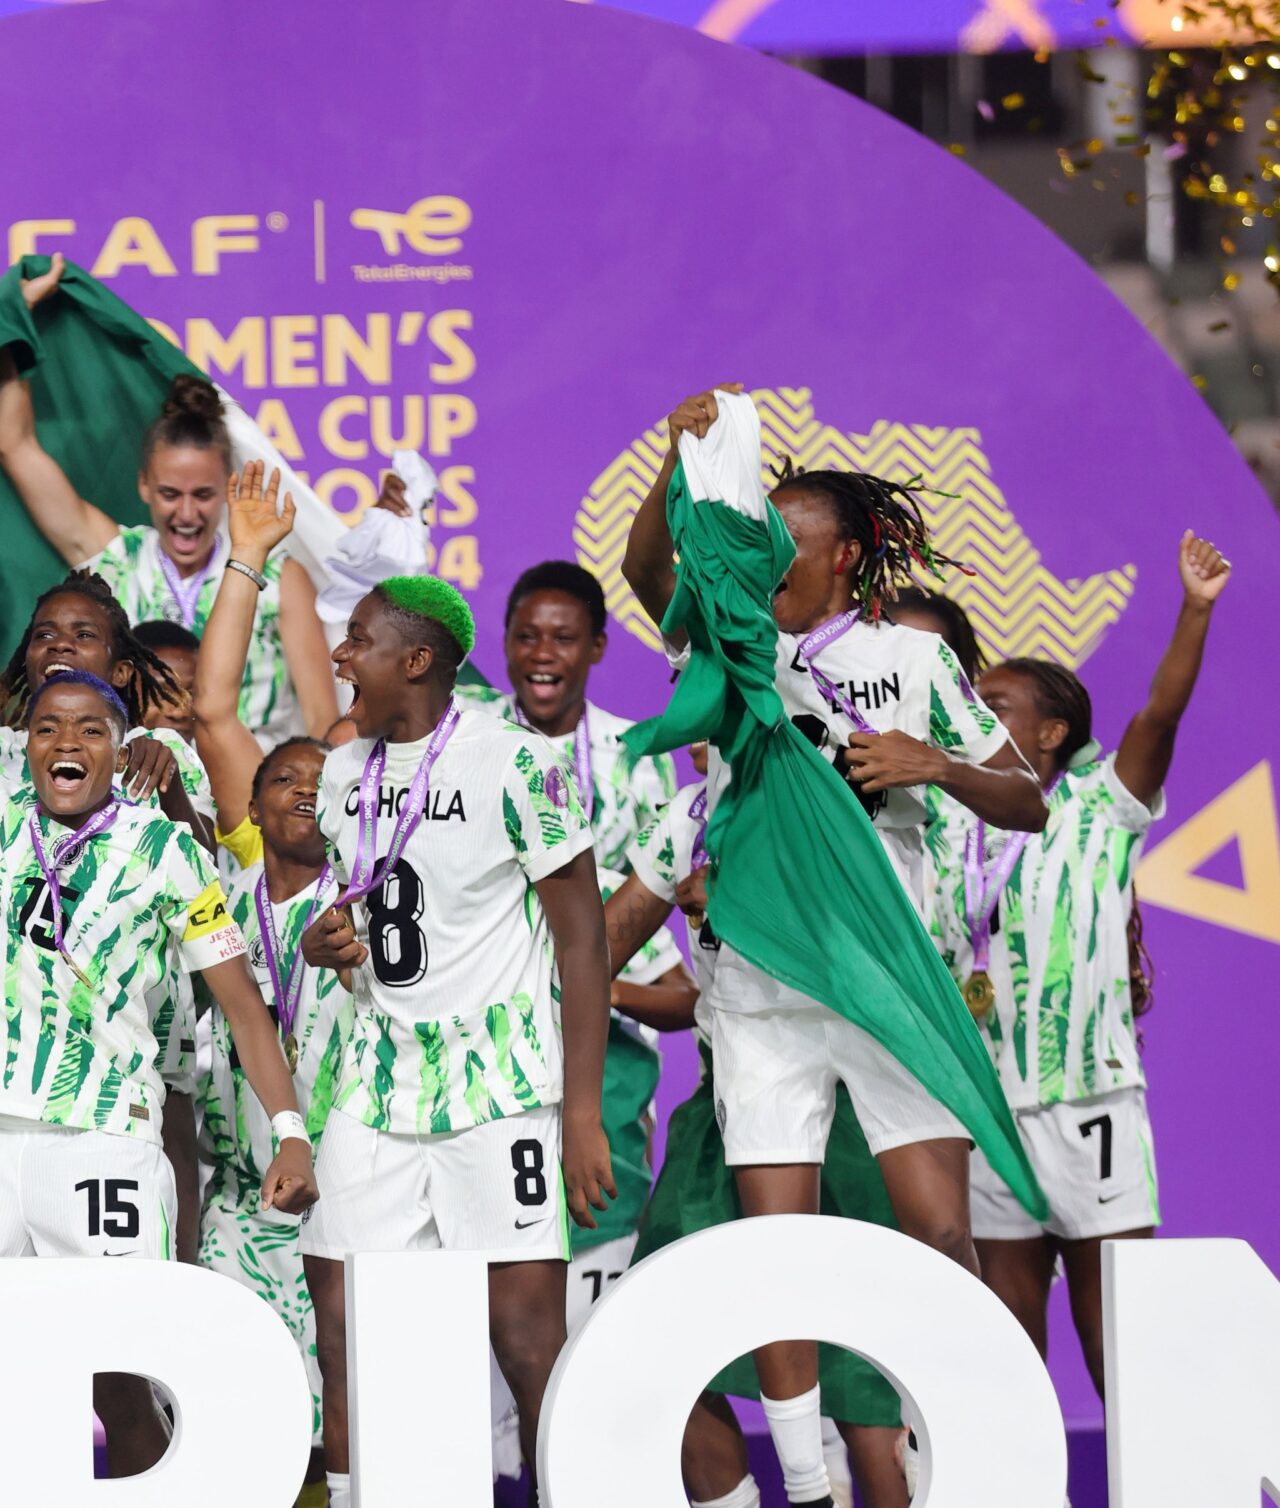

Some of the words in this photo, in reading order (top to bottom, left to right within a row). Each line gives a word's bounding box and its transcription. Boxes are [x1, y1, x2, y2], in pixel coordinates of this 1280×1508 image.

[351, 263, 474, 284] TotalEnergies
[144, 309, 477, 388] MEN'S
[318, 393, 478, 459] CUP
[362, 786, 374, 820] NATIONS
[398, 801, 418, 834] NATIONS
[386, 831, 404, 869] MOROCCO
[18, 877, 81, 952] 15
[366, 856, 428, 988] 8
[510, 1138, 548, 1206] 8
[1078, 1113, 1112, 1180] 7
[74, 1178, 140, 1239] 15
[582, 1269, 623, 1305] 1
